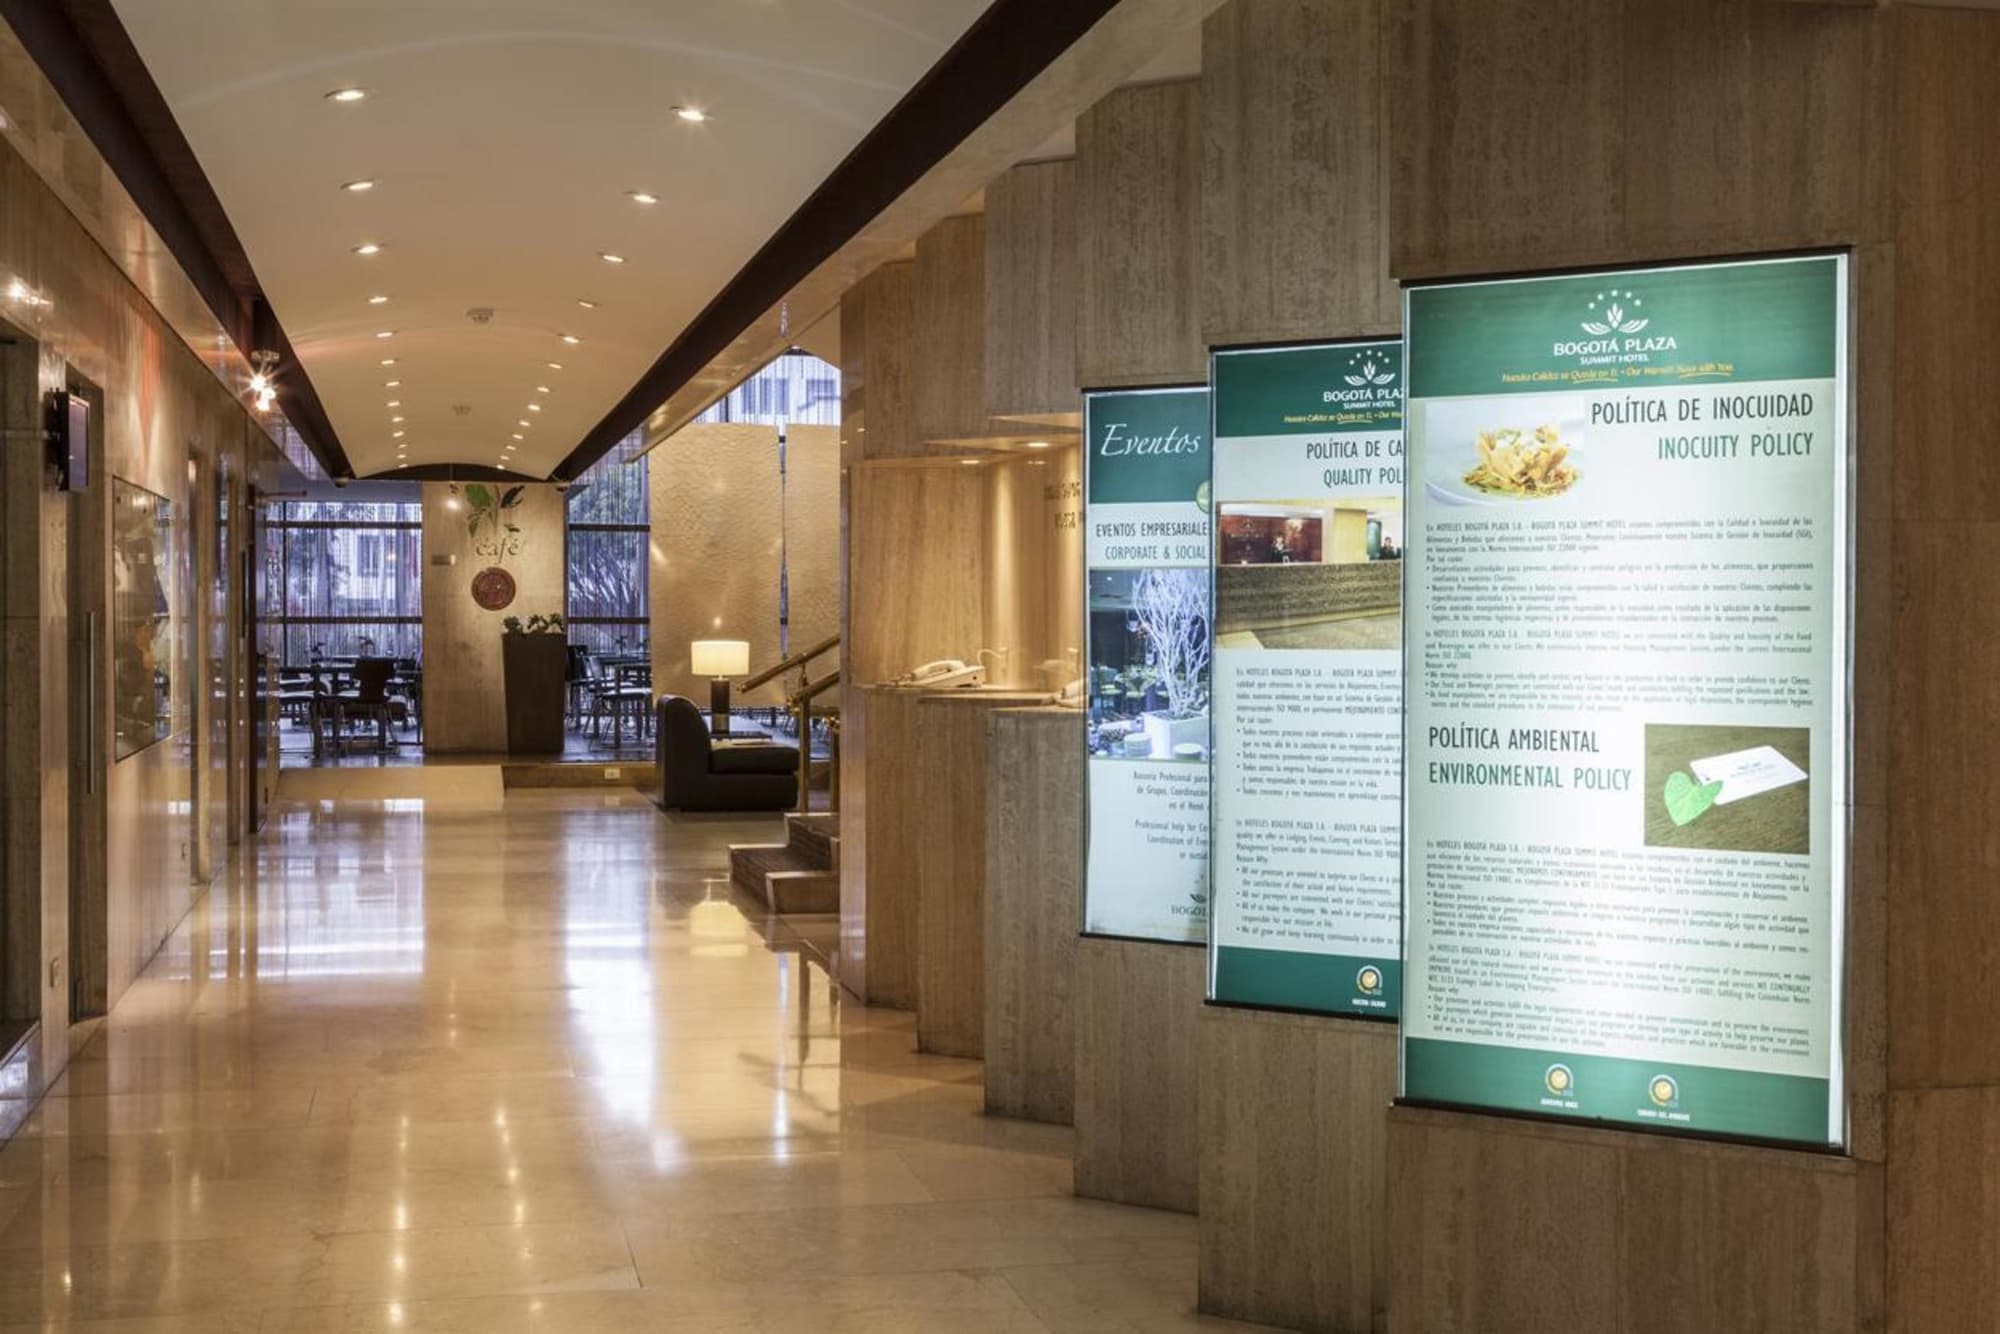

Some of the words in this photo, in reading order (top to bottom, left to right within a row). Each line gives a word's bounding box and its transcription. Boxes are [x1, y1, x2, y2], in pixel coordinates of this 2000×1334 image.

[1554, 338, 1619, 356] BOGOTÁ
[1626, 337, 1676, 351] PLAZA
[1580, 355, 1616, 365] SUMMIT
[1618, 354, 1648, 363] HOTEL
[1323, 389, 1373, 402] BOGOTÁ
[1377, 389, 1402, 399] PLA
[1592, 396, 1667, 425] POLÍTICA
[1679, 399, 1700, 421] DE
[1713, 394, 1813, 419] INOCUIDAD
[1100, 423, 1201, 456] Eventos
[1307, 437, 1358, 459] POLÍTICA
[1365, 441, 1380, 456] DE
[1659, 434, 1738, 459] INOCUITY
[1751, 433, 1813, 457] POLICY
[1324, 468, 1371, 488] QUALITY
[1096, 523, 1136, 537] EVENTOS
[475, 536, 522, 564] café
[1105, 545, 1157, 561] CORPORATE
[1164, 546, 1170, 559] &
[1176, 545, 1206, 559] SOCIAL
[1429, 722, 1500, 750] POLÍTICA
[1509, 729, 1599, 752] AMBIENTAL
[1429, 762, 1564, 788] ENVIRONMENTAL
[1574, 767, 1631, 791] POLICY
